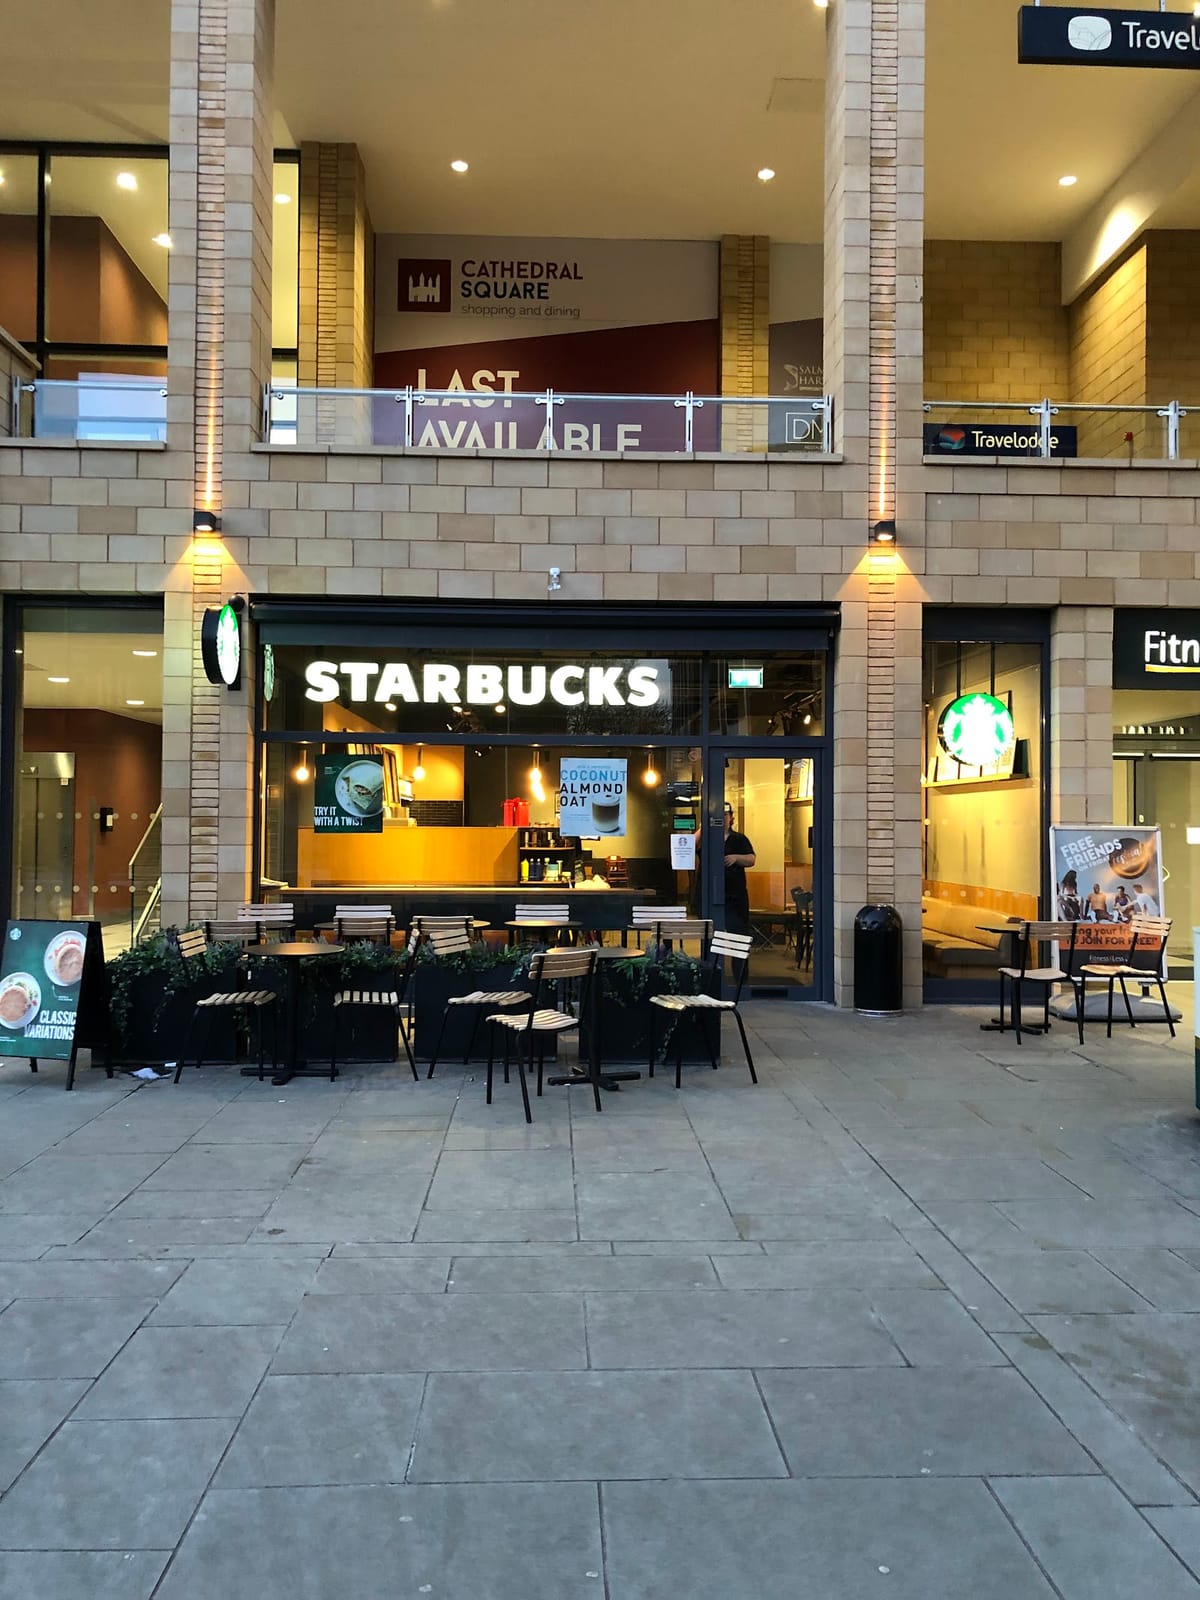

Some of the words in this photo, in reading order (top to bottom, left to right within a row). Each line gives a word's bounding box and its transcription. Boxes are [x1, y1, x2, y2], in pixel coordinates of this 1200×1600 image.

[461, 260, 584, 280] CATHEDRAL
[461, 281, 550, 300] SQUARE
[462, 304, 516, 317] shopping
[519, 305, 541, 316] and
[544, 305, 581, 319] dining
[417, 368, 521, 409] LAST
[1144, 630, 1200, 664] Fitn
[304, 660, 661, 707] STARBUCKS
[561, 769, 627, 782] COCONUT
[560, 782, 623, 795] ALMOND
[560, 795, 587, 807] OAT
[314, 806, 328, 816] TRY
[329, 806, 337, 816] IT
[314, 816, 333, 826] WITH
[333, 816, 340, 826] A
[340, 816, 363, 826] TWIST
[1060, 835, 1096, 858] FREE
[1065, 838, 1123, 869] FRIENDS
[1080, 936, 1103, 946] JOIN
[1105, 937, 1125, 946] FOR
[40, 1010, 77, 1026] CLASSIC
[24, 1024, 76, 1041] VARIATIONS
